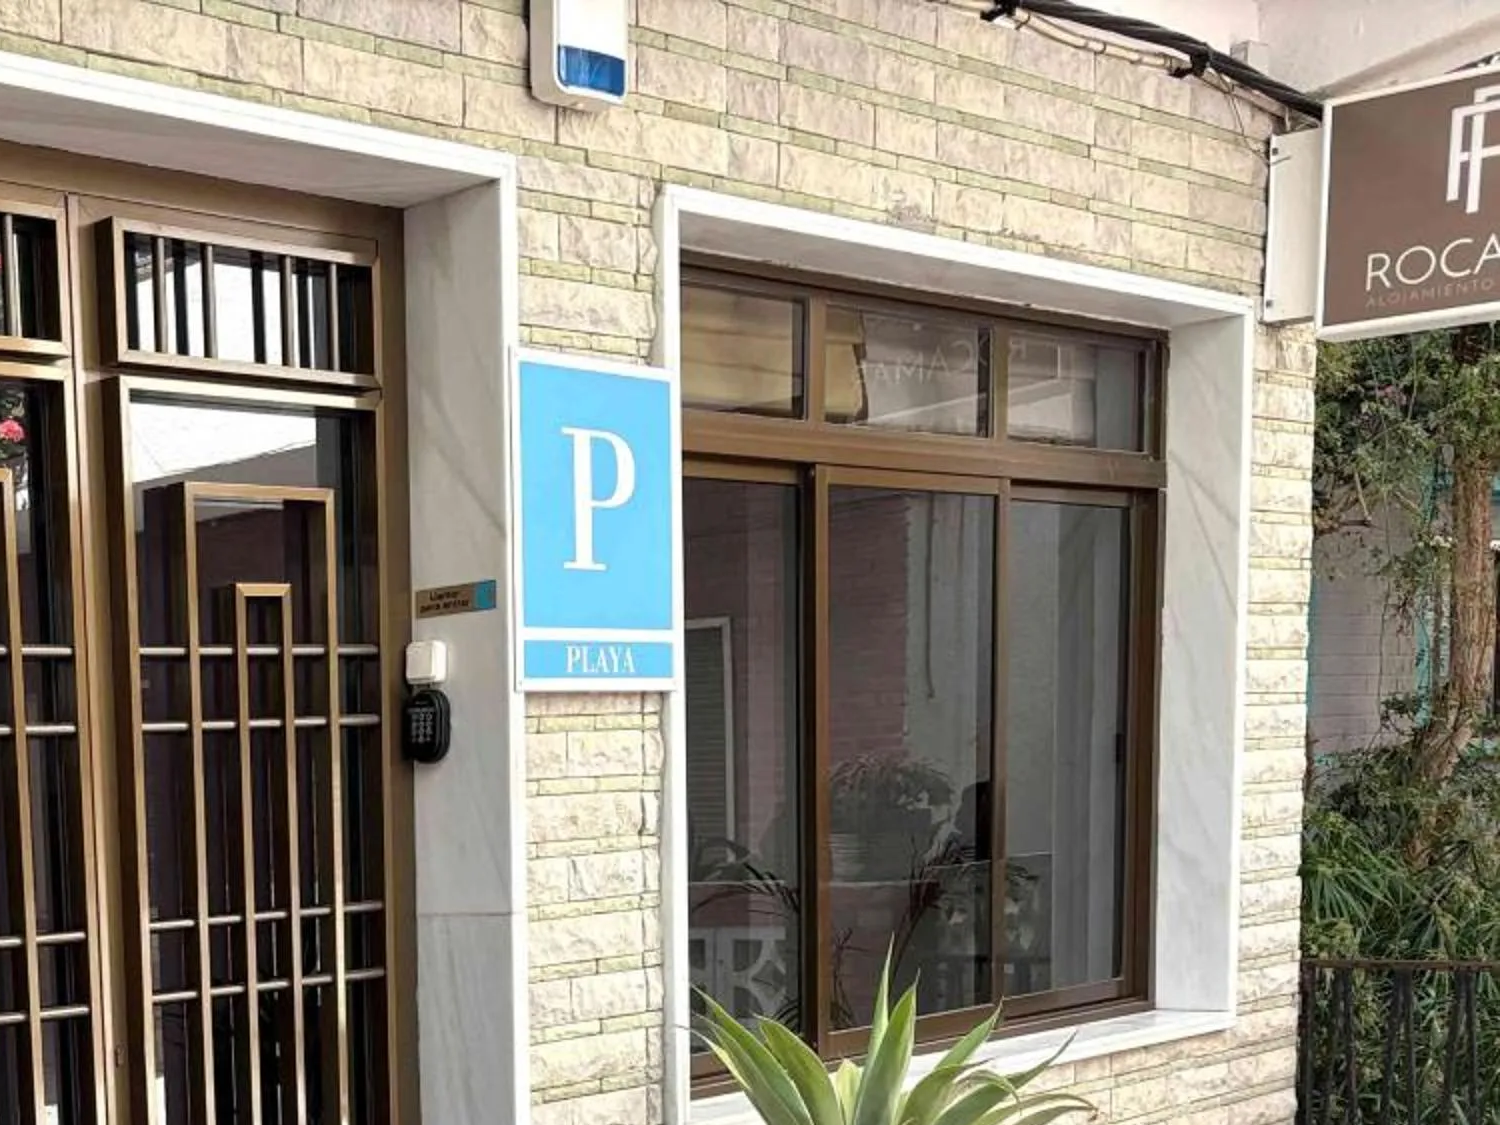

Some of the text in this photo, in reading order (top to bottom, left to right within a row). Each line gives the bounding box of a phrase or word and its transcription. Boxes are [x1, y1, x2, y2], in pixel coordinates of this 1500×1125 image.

[1366, 233, 1500, 291] ROCA
[1365, 278, 1494, 308] ALOJAMIENTO
[560, 426, 636, 571] P
[565, 645, 636, 674] PLAYA
